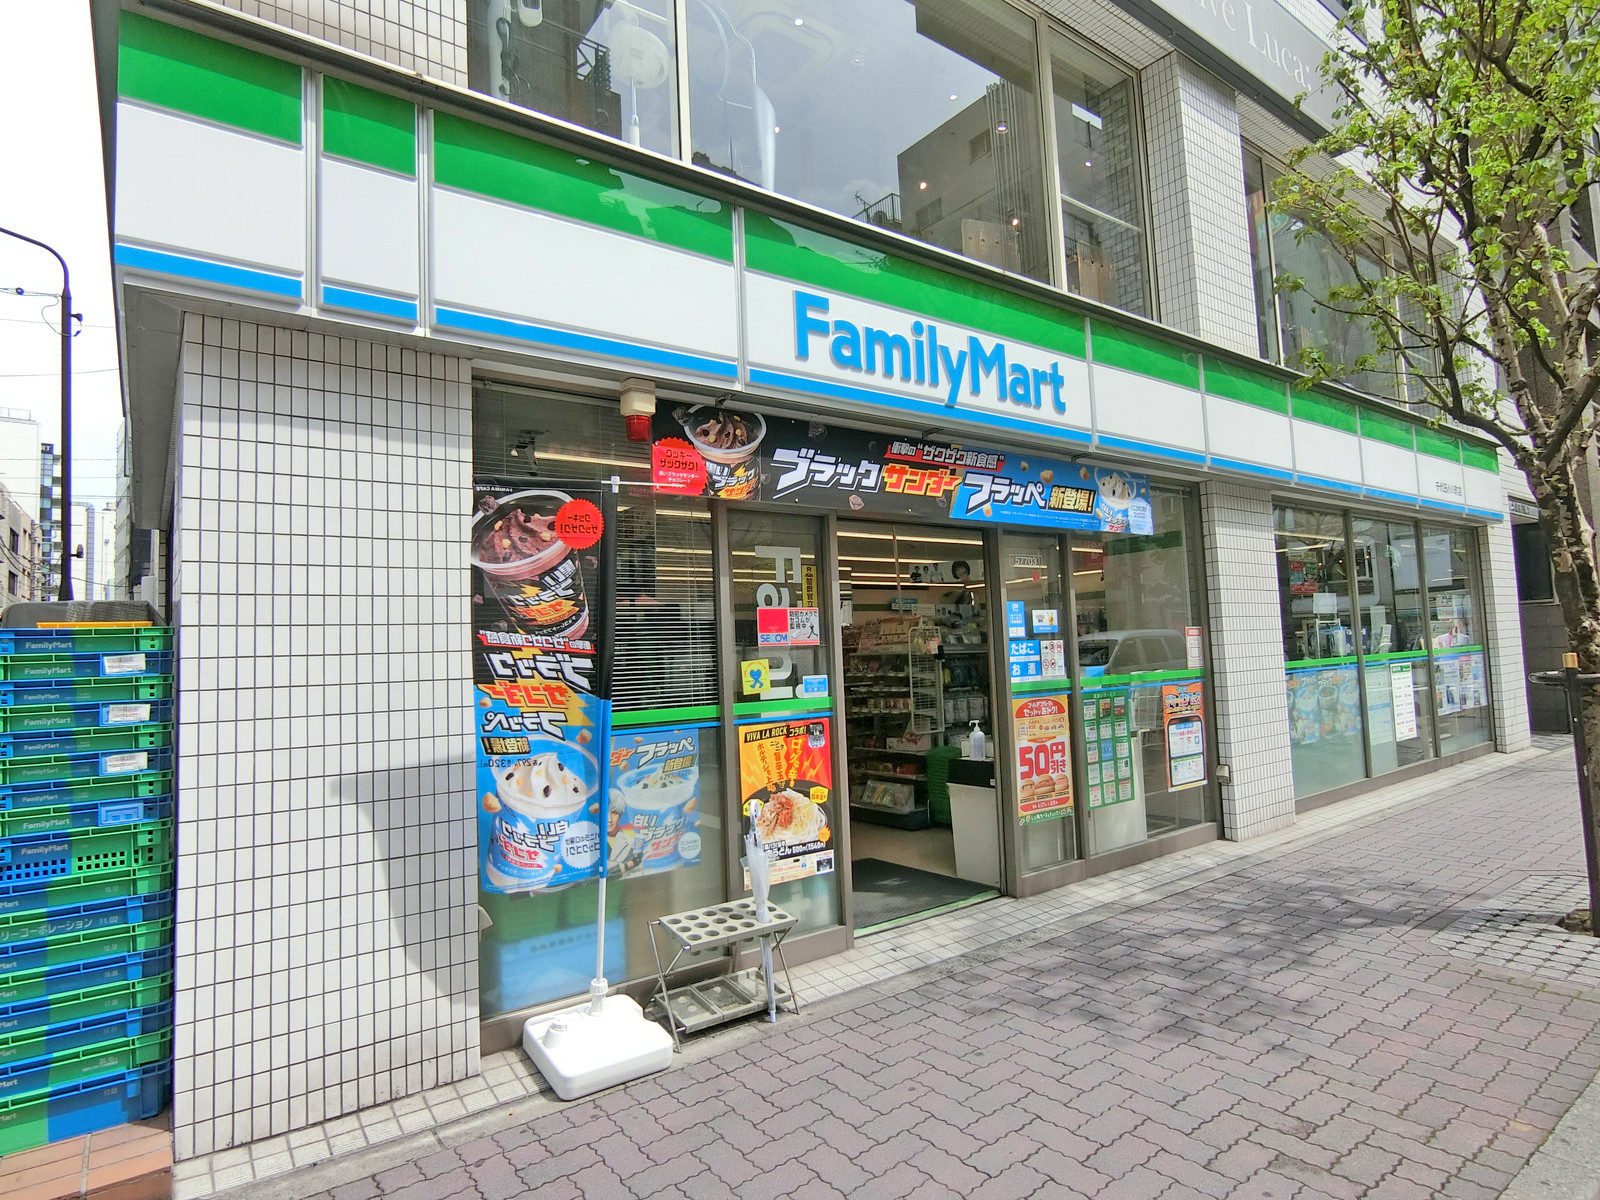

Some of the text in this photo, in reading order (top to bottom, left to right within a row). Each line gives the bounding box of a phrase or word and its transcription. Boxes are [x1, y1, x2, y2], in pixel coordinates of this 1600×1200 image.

[793, 290, 1066, 414] FamilyMart
[665, 450, 692, 459] クッキー
[712, 468, 755, 488] ブラック
[771, 447, 963, 498] ブラック サンダー
[964, 472, 1047, 515] フラッペ
[1049, 486, 1094, 513] 新登場!
[1014, 556, 1038, 566] 57703
[760, 633, 788, 643] SECOM
[25, 641, 73, 650] FamilyMart
[1010, 642, 1036, 655] たばこ
[24, 667, 72, 676] FamilyMart
[24, 717, 71, 726] FamilyMart
[746, 731, 761, 742] VIVA
[762, 730, 770, 738] LA
[771, 726, 788, 737] ROCK
[23, 743, 60, 751] FamilyMart
[635, 737, 696, 769] フラッペ
[23, 818, 70, 829] FamilyMart
[21, 843, 69, 855] FamilyMart
[99, 915, 119, 925] 11.02
